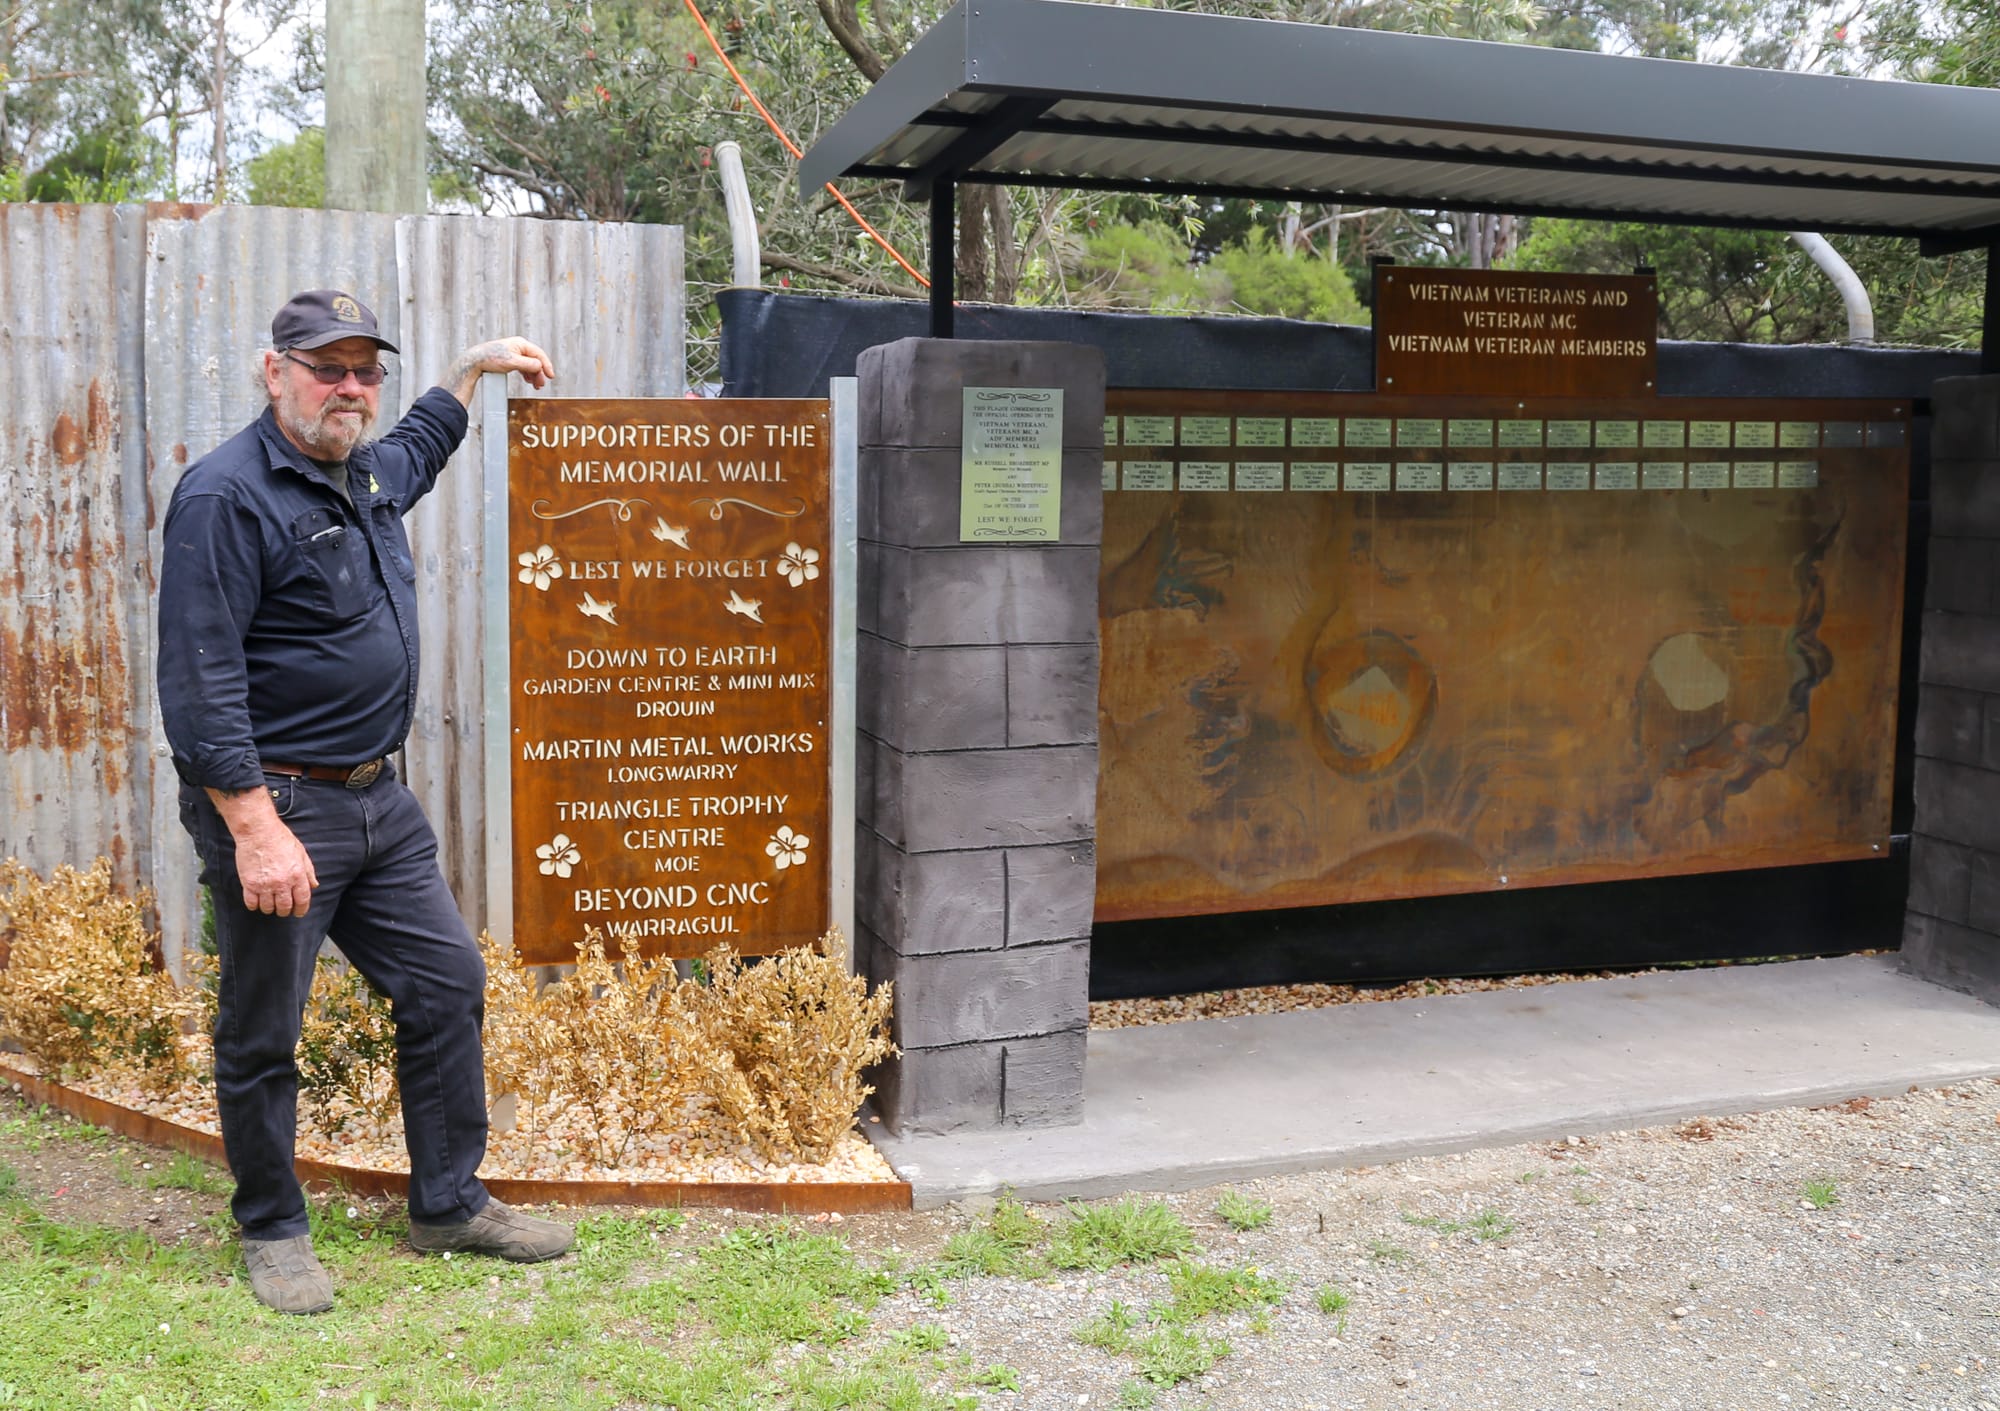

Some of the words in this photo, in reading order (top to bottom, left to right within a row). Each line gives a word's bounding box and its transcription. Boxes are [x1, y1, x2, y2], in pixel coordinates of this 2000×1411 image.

[1410, 284, 1490, 302] VIETNAM
[1494, 288, 1586, 305] VETERANS
[1592, 290, 1628, 306] AND
[1464, 311, 1545, 329] VETERAN
[1550, 314, 1576, 330] MC
[1388, 335, 1470, 352] VIETNAM
[1474, 337, 1555, 354] VETERAN
[1561, 340, 1646, 356] MEMBERS
[522, 424, 710, 449] SUPPORTERS
[719, 424, 756, 448] OF
[764, 424, 816, 448] THE
[561, 460, 709, 483] MEMORIAL
[718, 460, 788, 482] WALL
[570, 561, 622, 580] LEST
[632, 560, 667, 579] WE
[675, 560, 769, 578] FORGET
[567, 648, 648, 669] DOWN
[656, 647, 687, 667] TO
[696, 646, 777, 666] EARTH
[523, 677, 611, 696] GARDEN
[618, 676, 700, 693] CENTRE
[708, 675, 722, 691] &
[728, 674, 772, 691] MINI
[780, 673, 816, 690] MIX
[636, 701, 714, 718] DROUIN
[523, 739, 622, 760] MARTIN
[630, 736, 714, 758] METAL
[720, 733, 814, 755] WORKS
[608, 764, 738, 784] LONGWARRY
[556, 798, 680, 822] TRIANGLE
[688, 794, 788, 816] TROPHY
[624, 827, 725, 850] CENTRE
[655, 856, 700, 872] MOE
[574, 885, 698, 912] BEYOND
[706, 882, 770, 906] CNC
[606, 916, 740, 938] WARRAGUL
